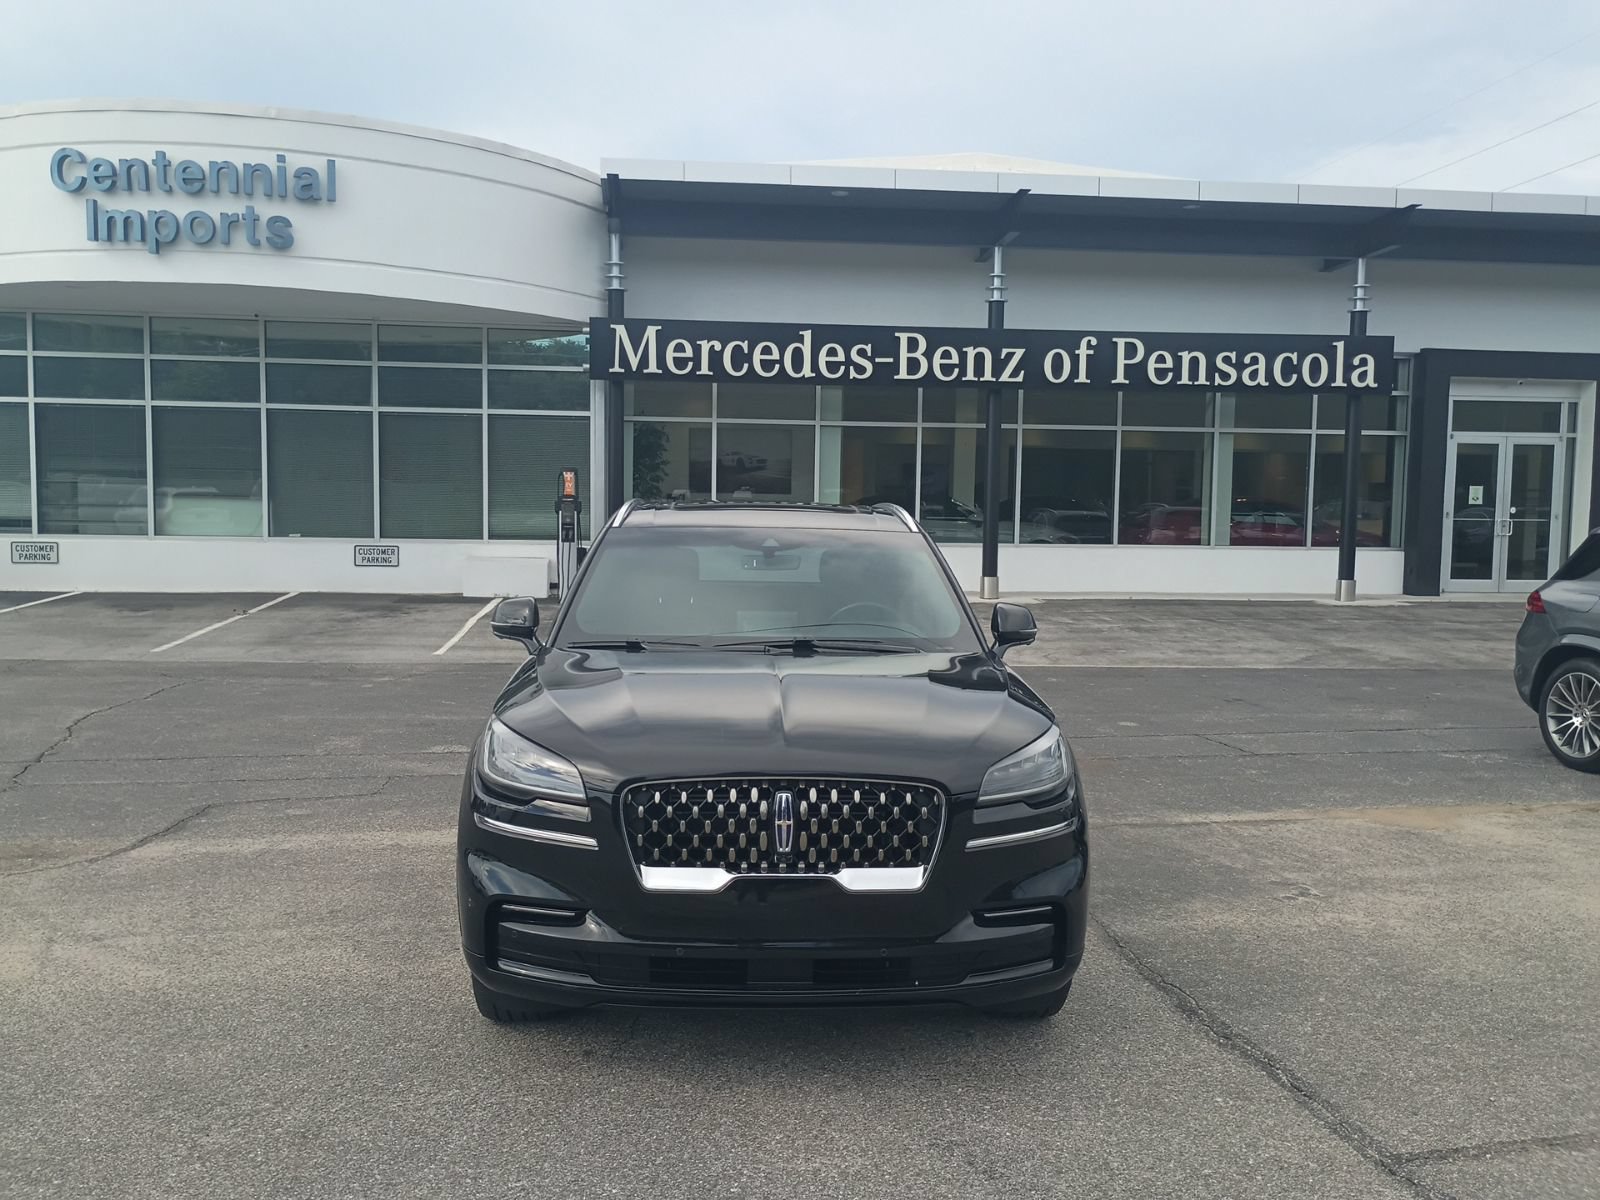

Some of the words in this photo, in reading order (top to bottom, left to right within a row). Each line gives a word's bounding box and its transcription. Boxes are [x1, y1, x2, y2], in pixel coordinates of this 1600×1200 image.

[50, 147, 336, 202] Centennial
[86, 198, 294, 254] Imports
[609, 323, 1027, 383] Mercedes-Benz
[1043, 335, 1098, 384] of
[1111, 337, 1378, 388] Pensacola
[15, 544, 55, 553] CUSTOMER
[358, 547, 396, 556] CUSTOMER
[18, 552, 52, 561] PARKING
[361, 556, 393, 564] PARKING
